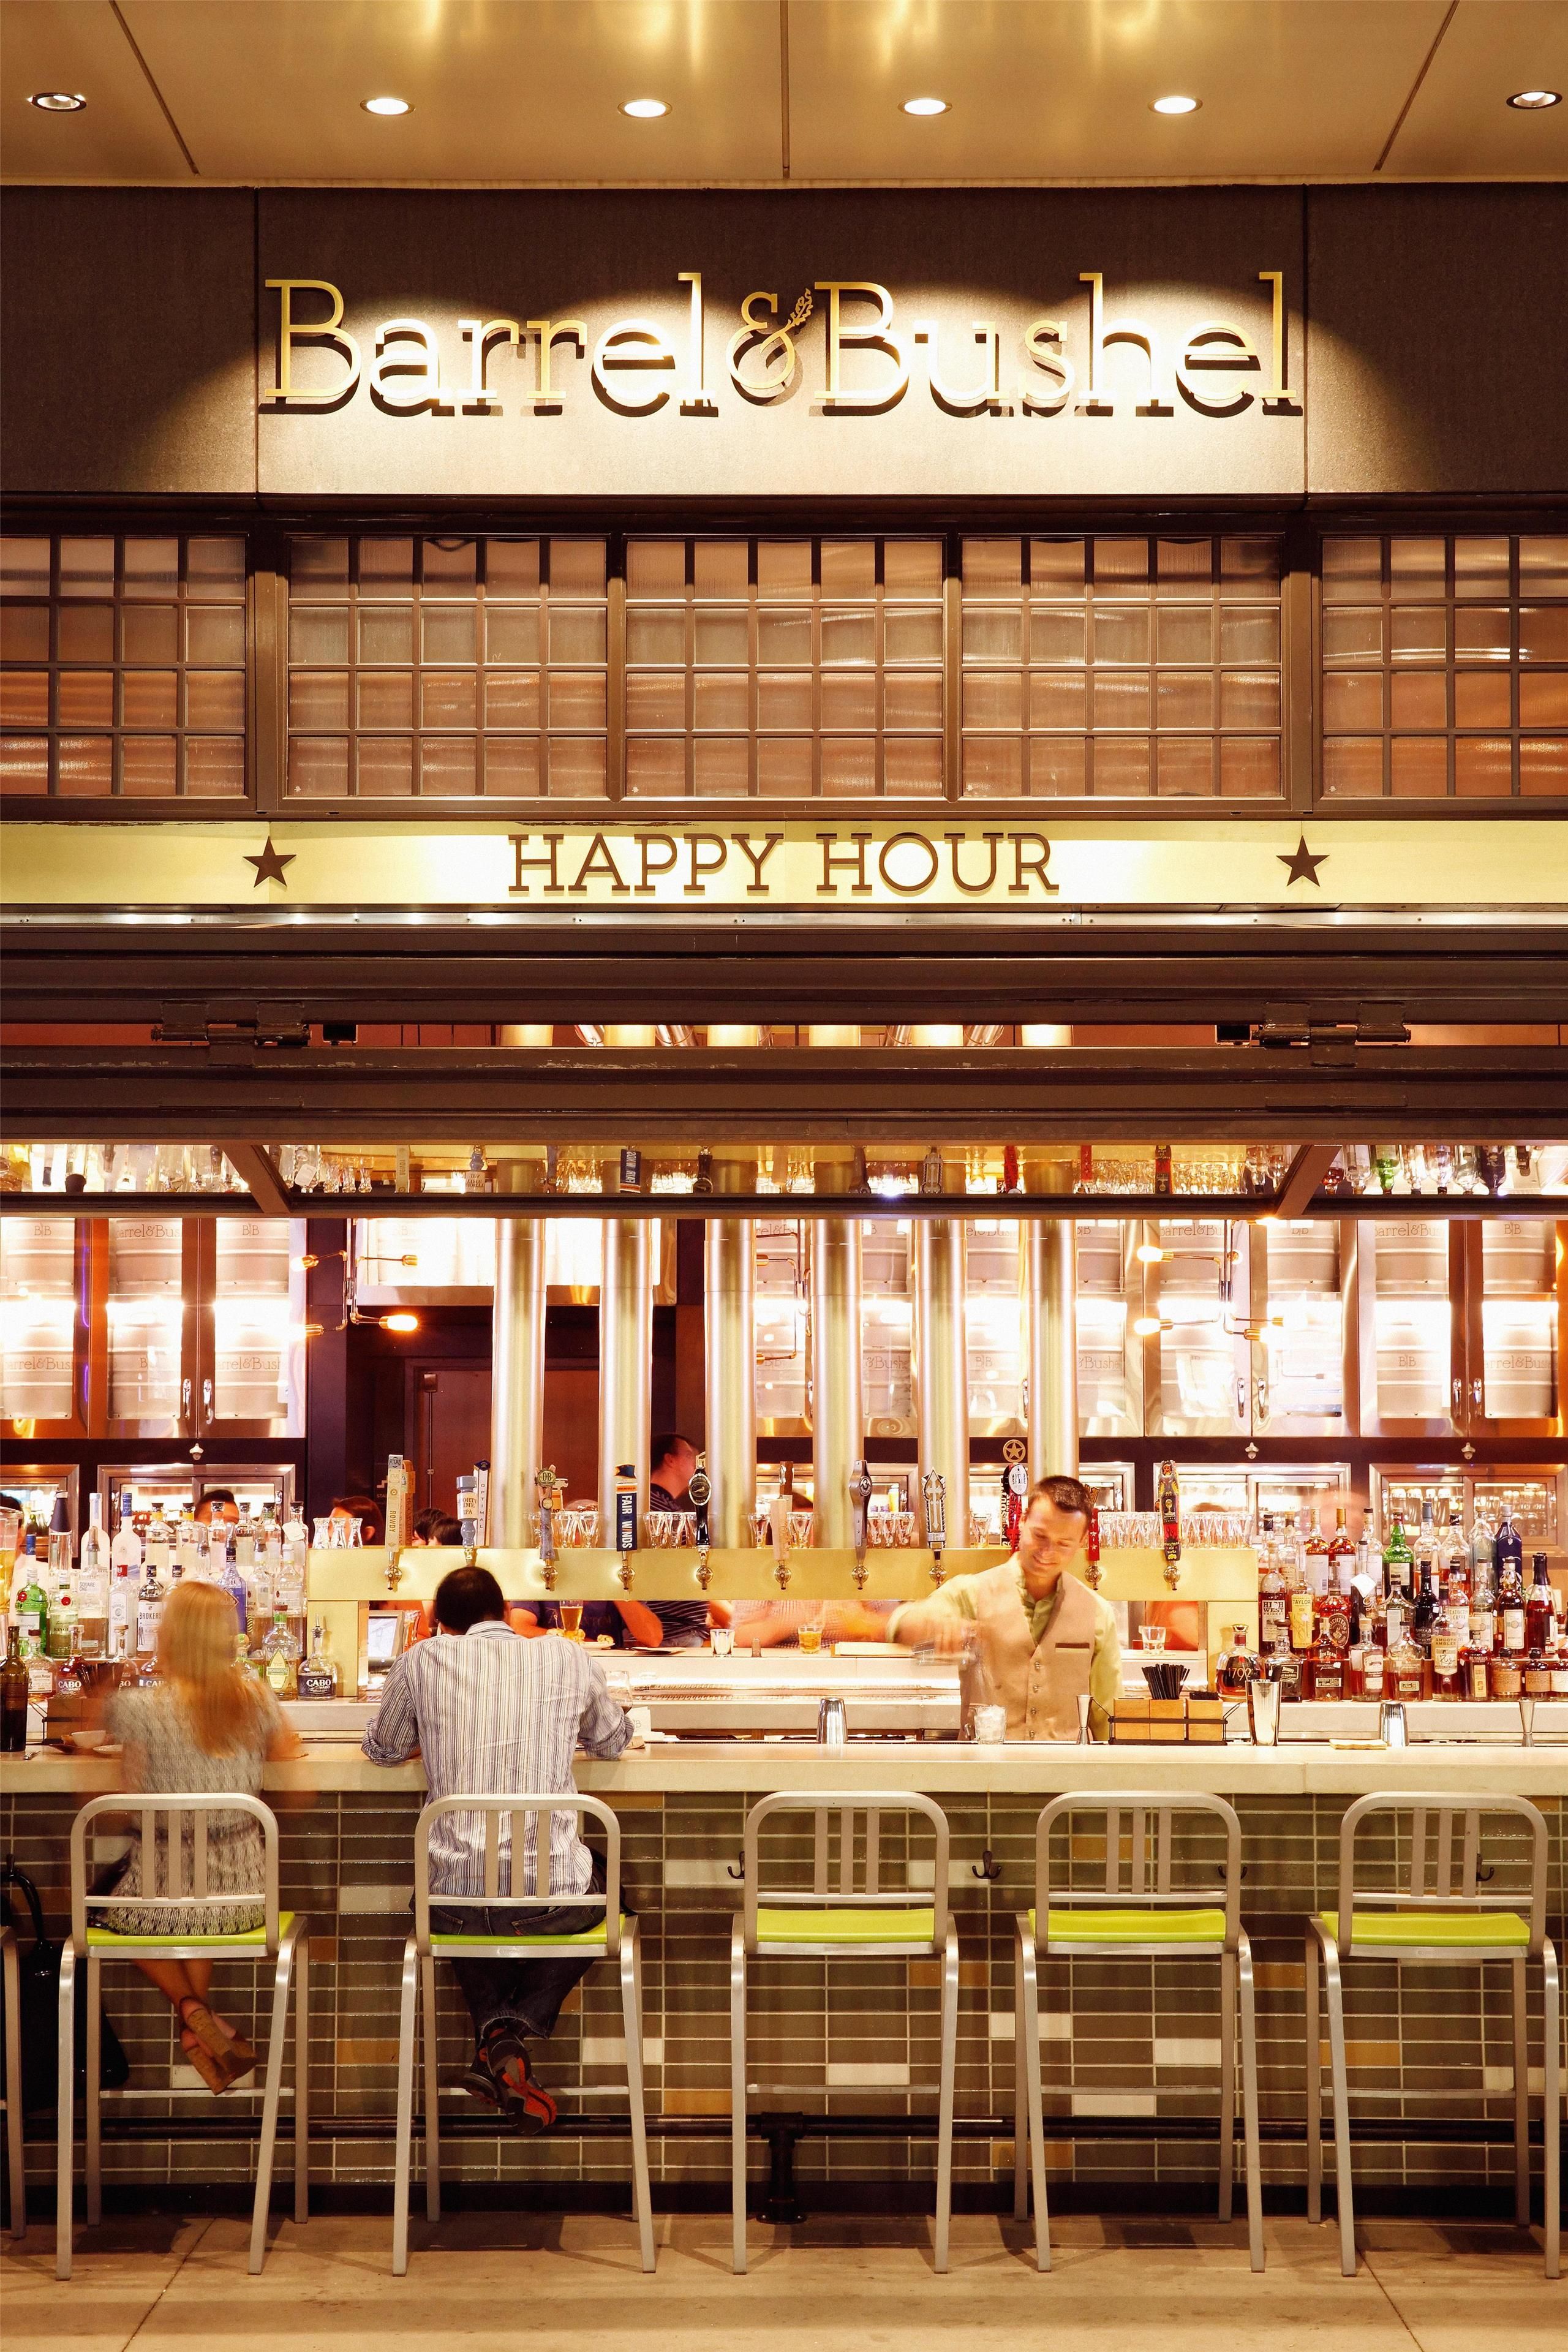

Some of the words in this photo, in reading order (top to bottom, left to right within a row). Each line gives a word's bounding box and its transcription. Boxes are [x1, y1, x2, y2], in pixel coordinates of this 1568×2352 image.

[507, 832, 785, 892] HAPPY
[815, 832, 1060, 892] HOUR
[542, 1472, 552, 1481] DB
[622, 1495, 633, 1517] FAIR
[621, 1520, 633, 1549] WINDS
[1228, 1667, 1252, 1681] 1792
